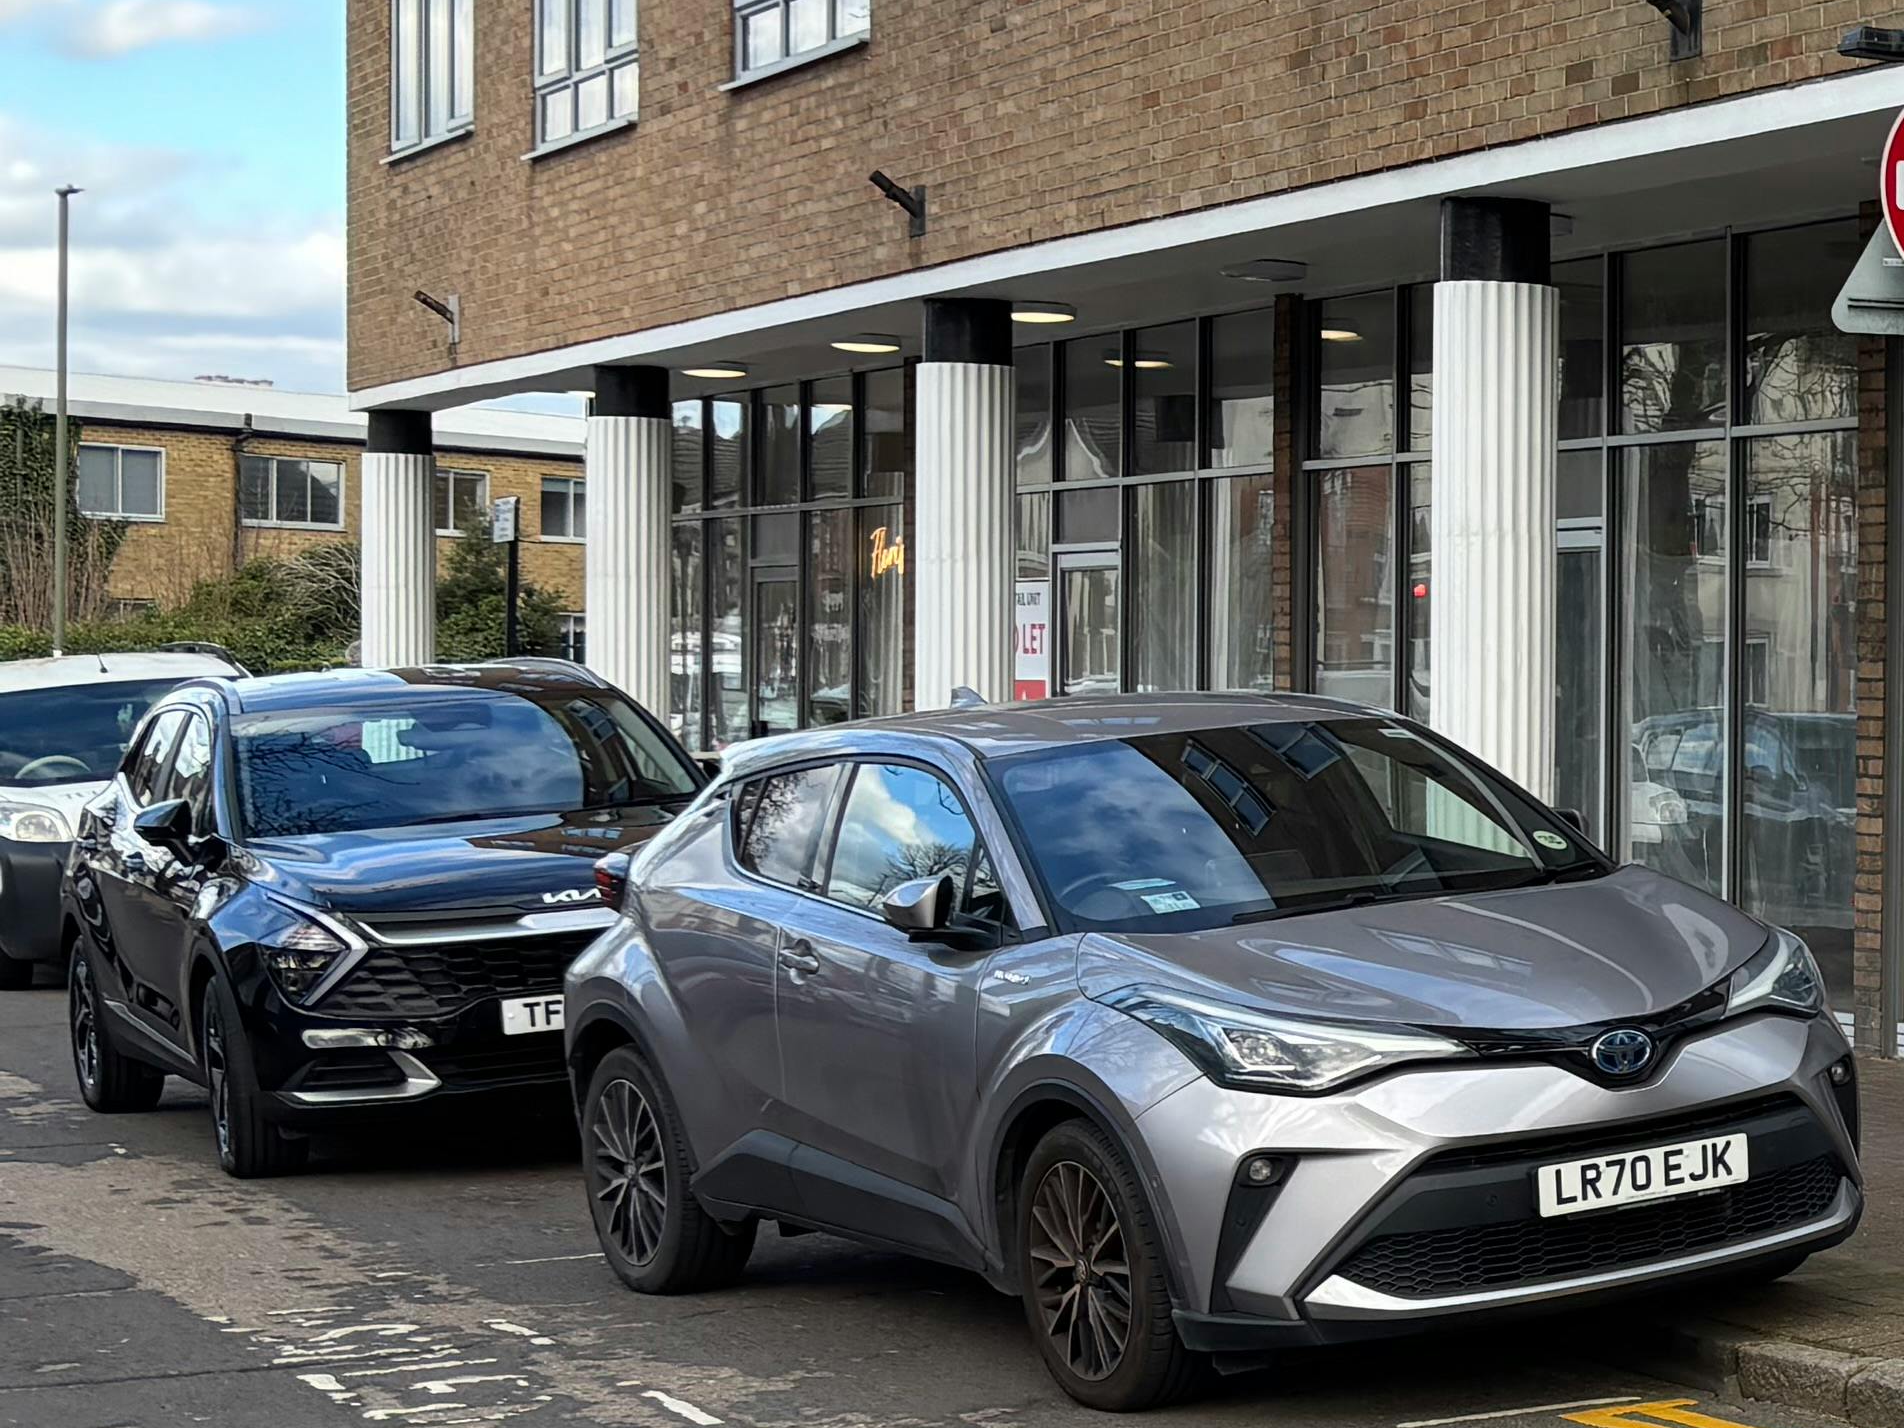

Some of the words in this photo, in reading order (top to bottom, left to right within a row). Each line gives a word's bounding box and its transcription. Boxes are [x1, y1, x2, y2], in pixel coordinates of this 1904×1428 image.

[1022, 623, 1046, 655] LET
[1554, 1155, 1652, 1206] LR70
[1664, 1139, 1733, 1186] EJK
